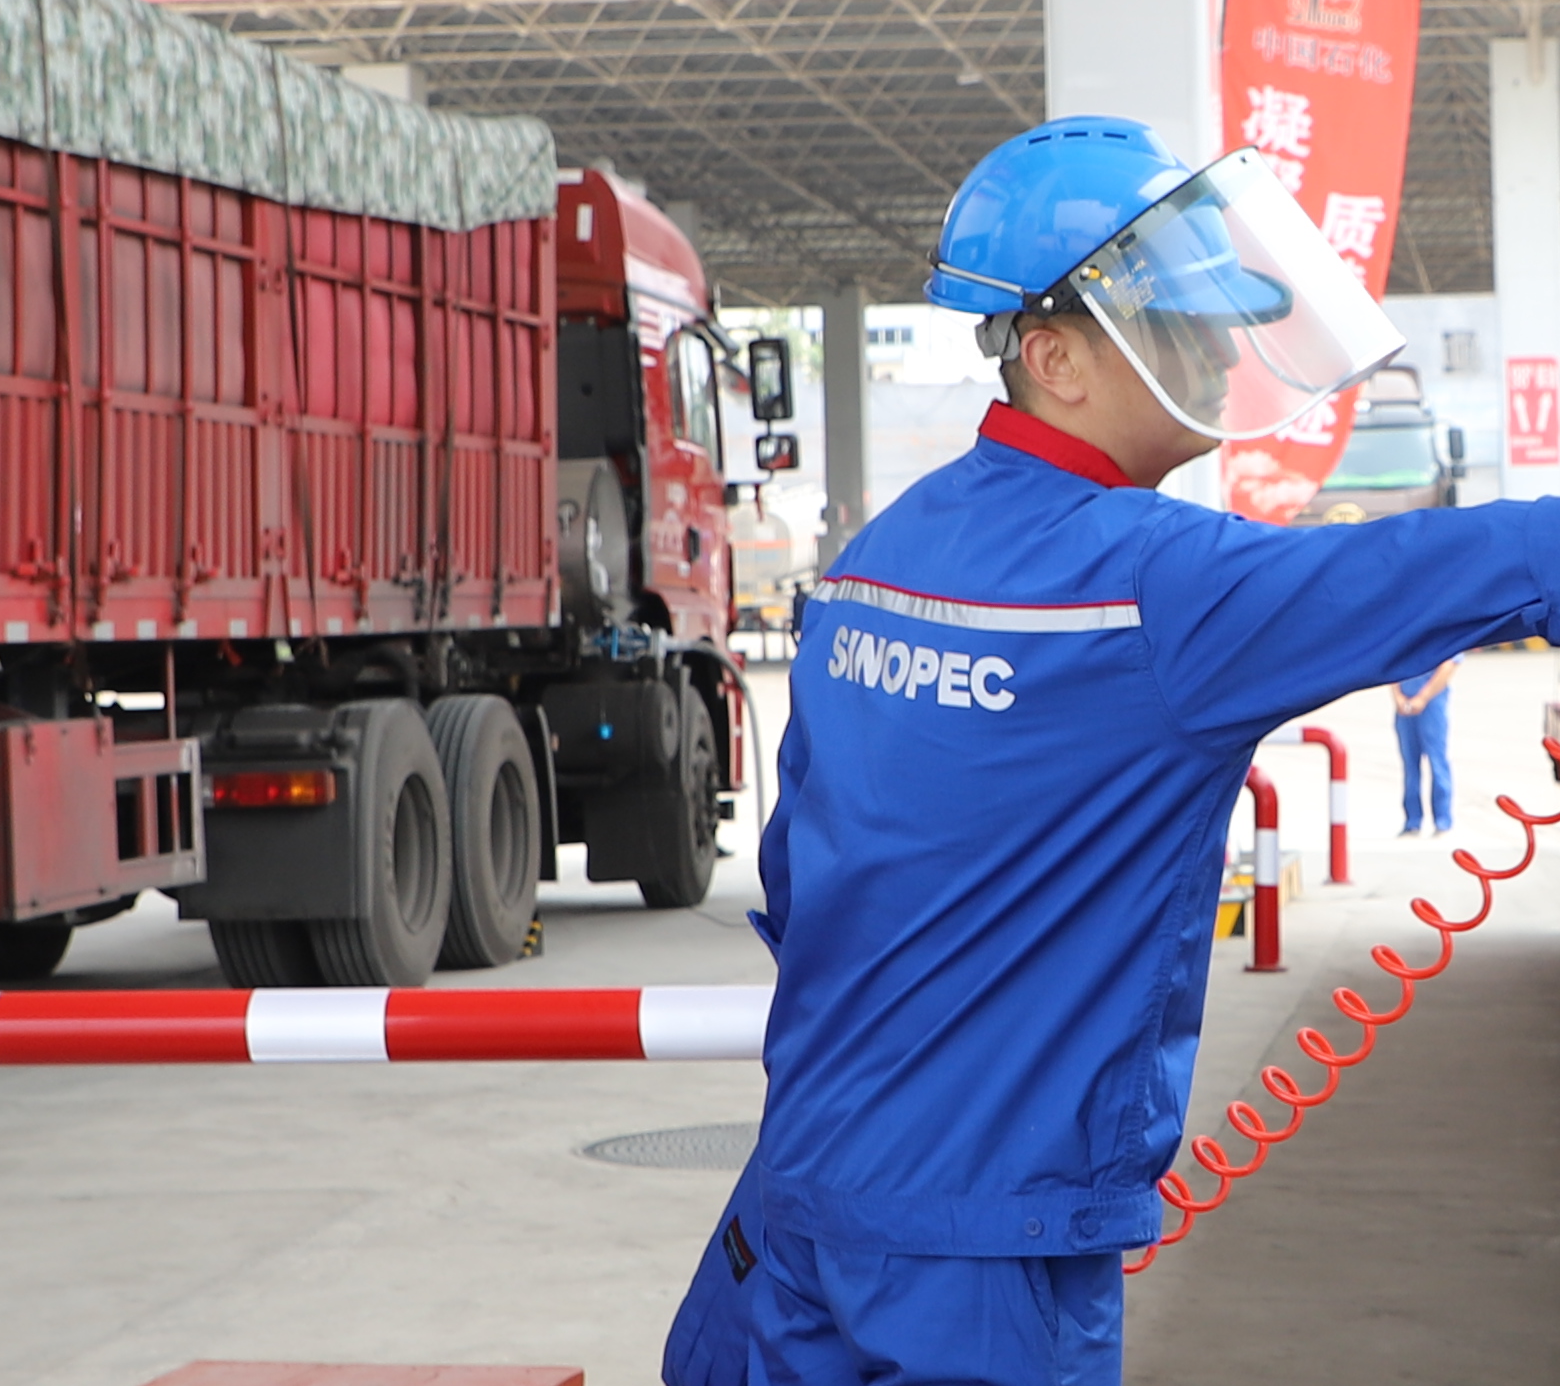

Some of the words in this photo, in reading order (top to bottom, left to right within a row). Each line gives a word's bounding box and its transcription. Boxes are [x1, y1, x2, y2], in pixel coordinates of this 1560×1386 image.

[1254, 24, 1393, 83] 中国石化
[827, 625, 1017, 713] SINOPEC
